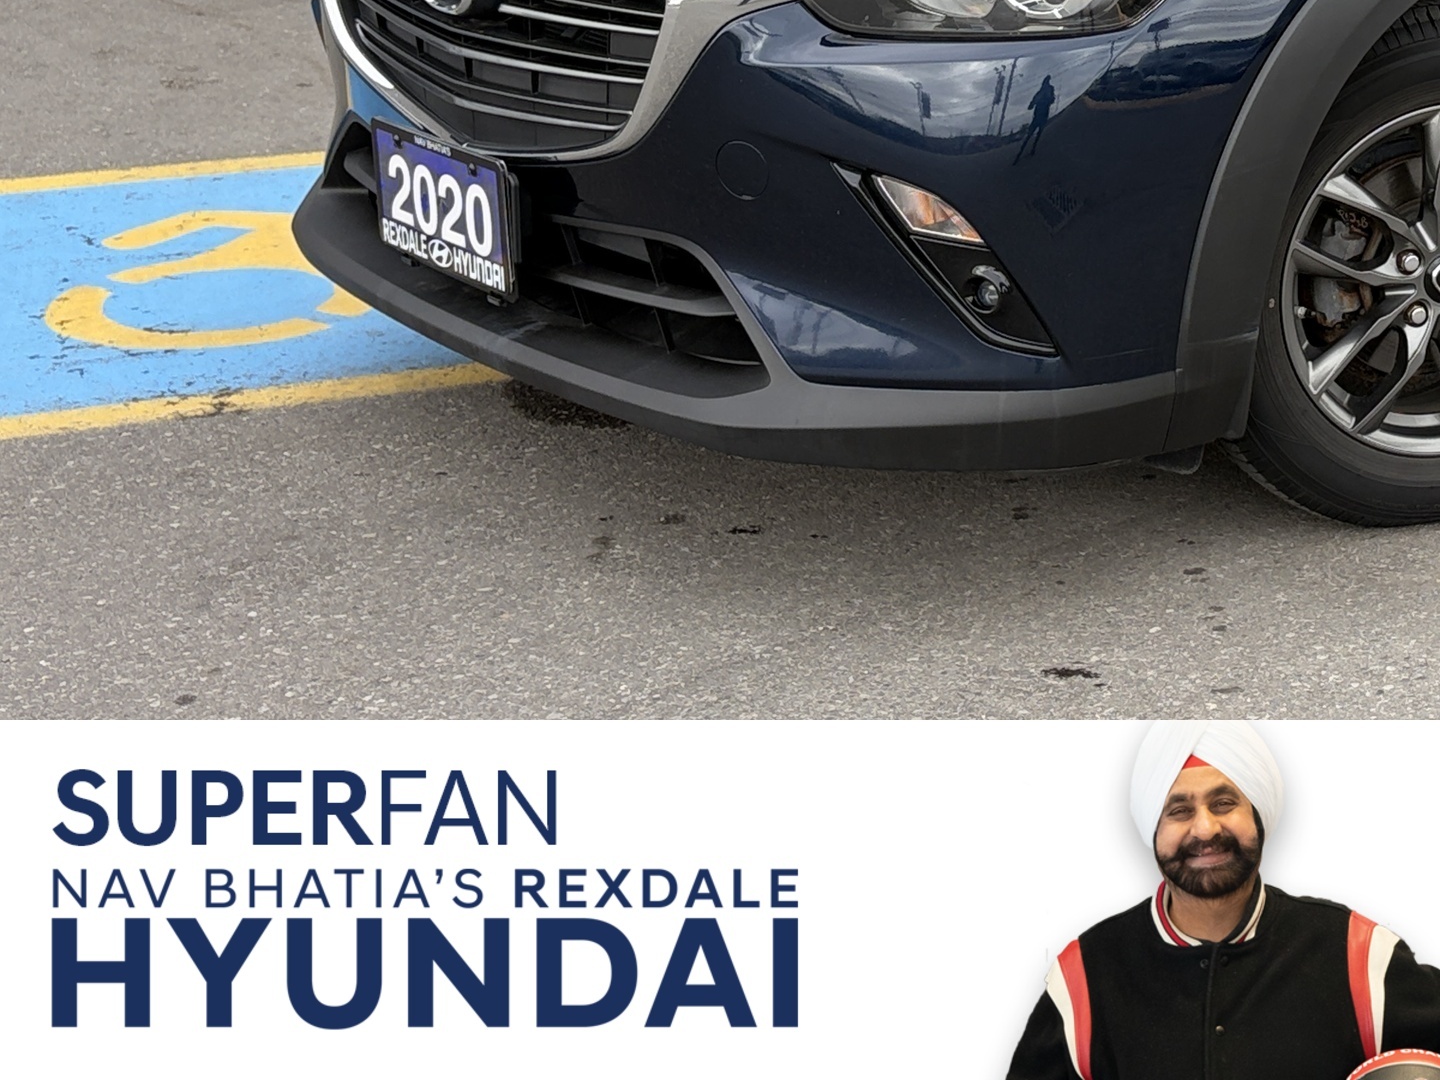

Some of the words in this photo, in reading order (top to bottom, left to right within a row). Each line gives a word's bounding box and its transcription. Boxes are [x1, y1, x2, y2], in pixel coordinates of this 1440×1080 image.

[388, 154, 493, 257] 2020
[382, 217, 429, 260] REXDALE
[453, 246, 506, 292] HYUNDAI
